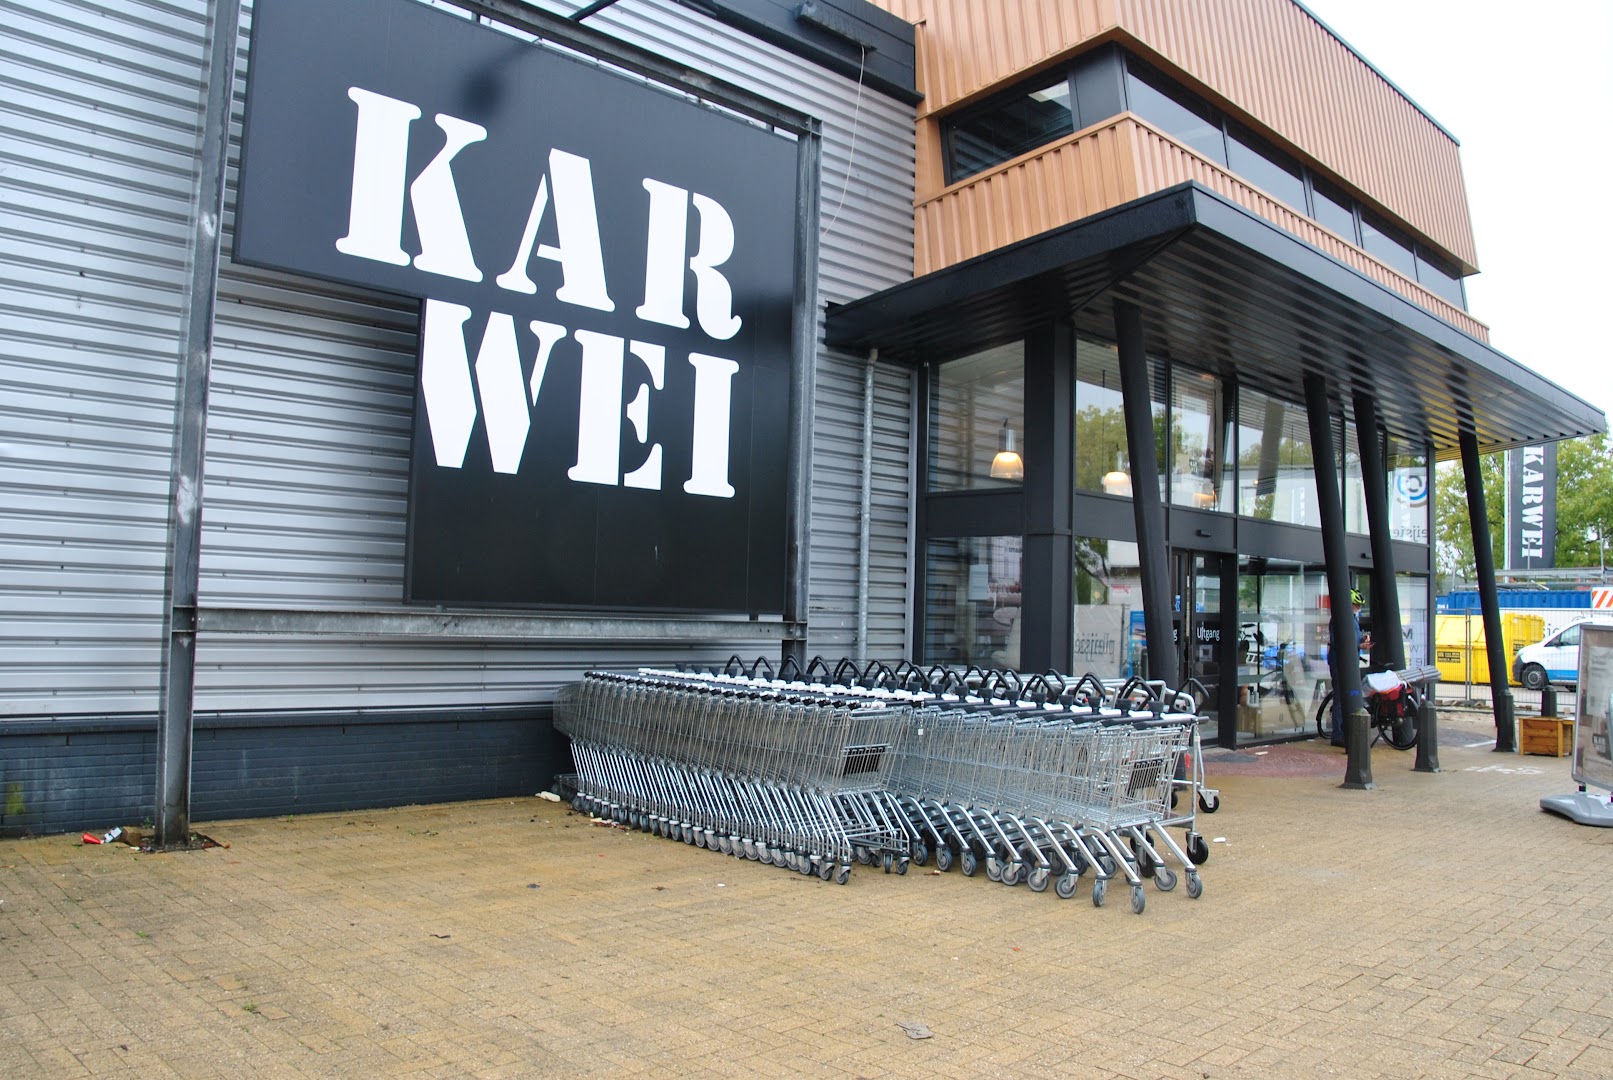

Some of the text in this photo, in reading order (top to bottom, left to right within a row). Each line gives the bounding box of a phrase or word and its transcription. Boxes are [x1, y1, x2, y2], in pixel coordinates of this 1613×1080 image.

[336, 87, 743, 341] KAR
[421, 298, 740, 499] WEI
[1522, 446, 1544, 559] KARWEI
